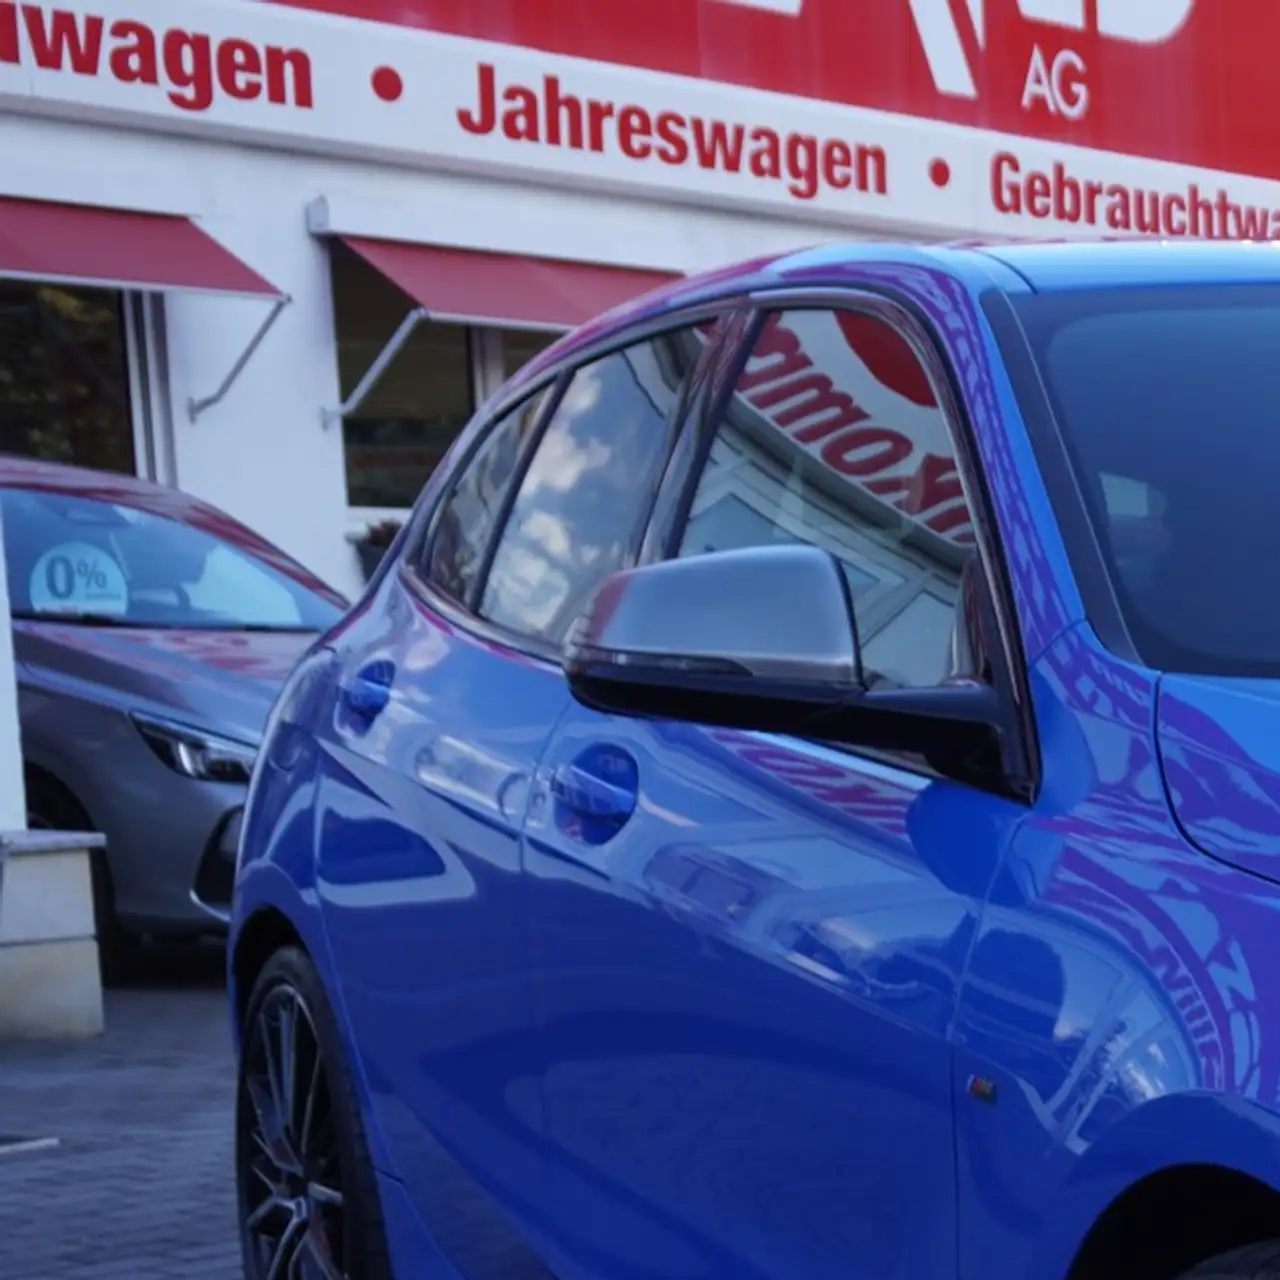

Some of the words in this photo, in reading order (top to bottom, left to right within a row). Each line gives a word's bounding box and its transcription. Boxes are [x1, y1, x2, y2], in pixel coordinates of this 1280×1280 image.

[1021, 42, 1088, 120] AG
[456, 62, 888, 199] Jahreswagen
[47, 555, 106, 599] 0%
